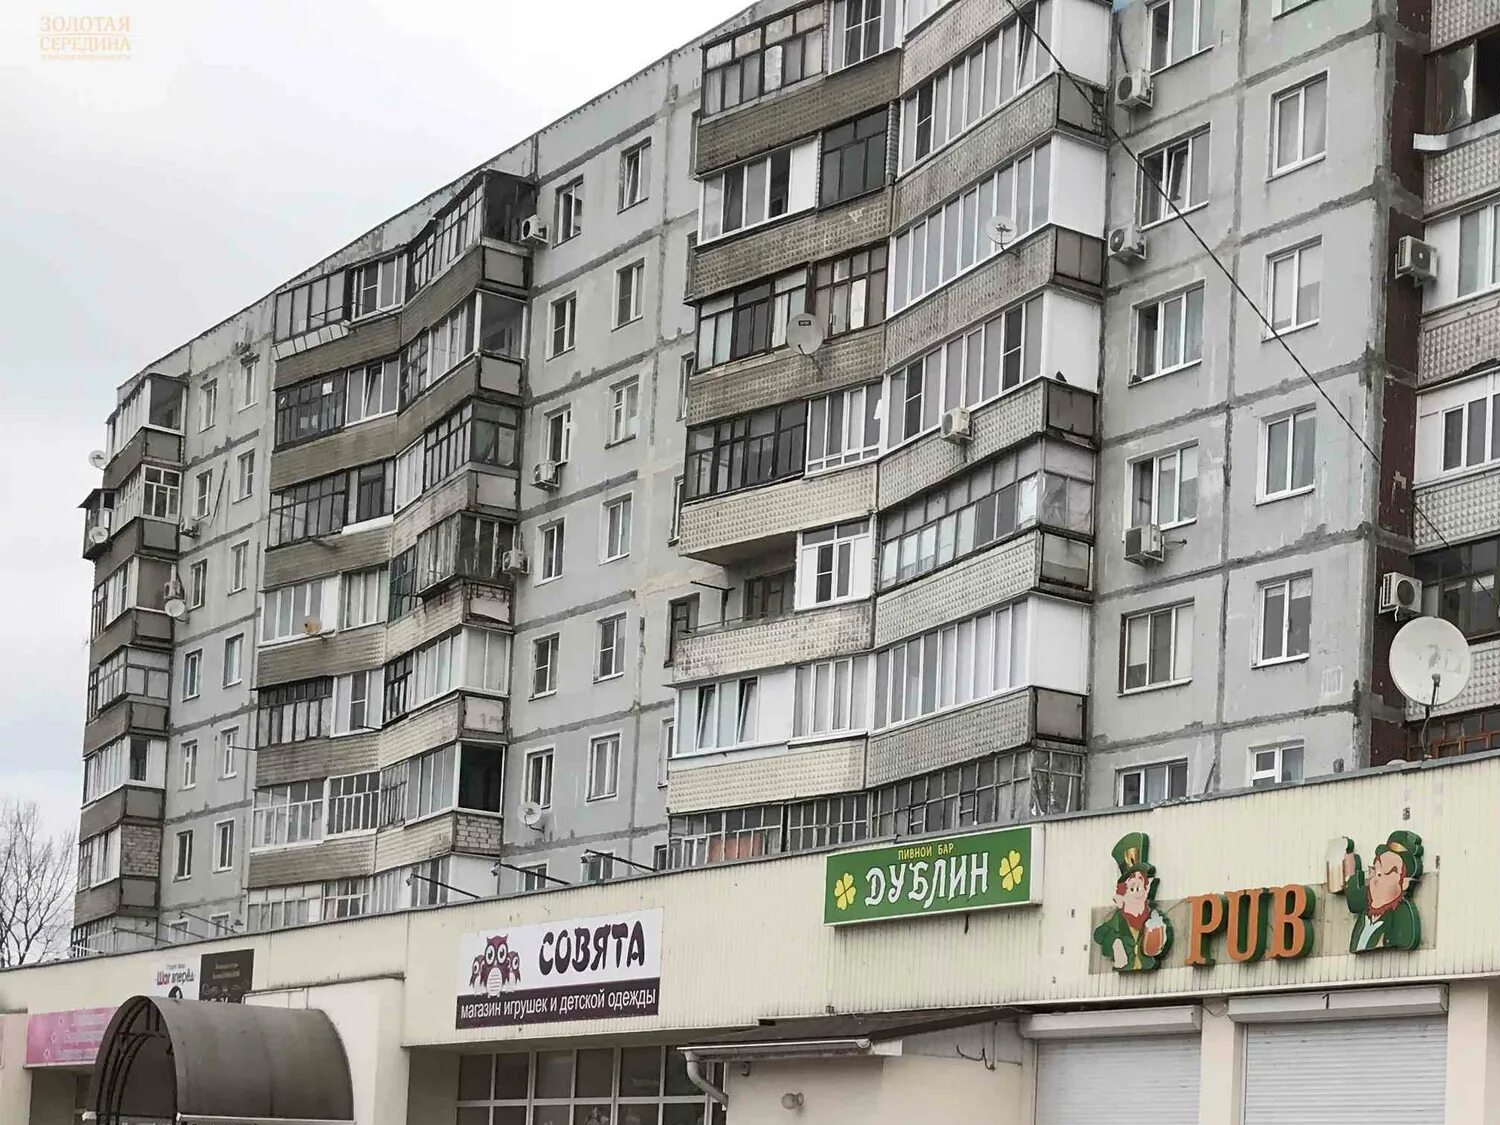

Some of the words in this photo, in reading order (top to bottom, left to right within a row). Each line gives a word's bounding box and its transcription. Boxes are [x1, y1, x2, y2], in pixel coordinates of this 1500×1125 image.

[937, 842, 955, 855] БАР
[865, 852, 990, 909] ДУБЛИН
[538, 920, 645, 976] СОВЯТА
[1185, 883, 1314, 967] PUB
[460, 1000, 502, 1019] магазин
[503, 997, 549, 1020] игрушек
[550, 996, 558, 1012] и
[559, 988, 606, 1015] детской
[607, 988, 657, 1012] одежды
